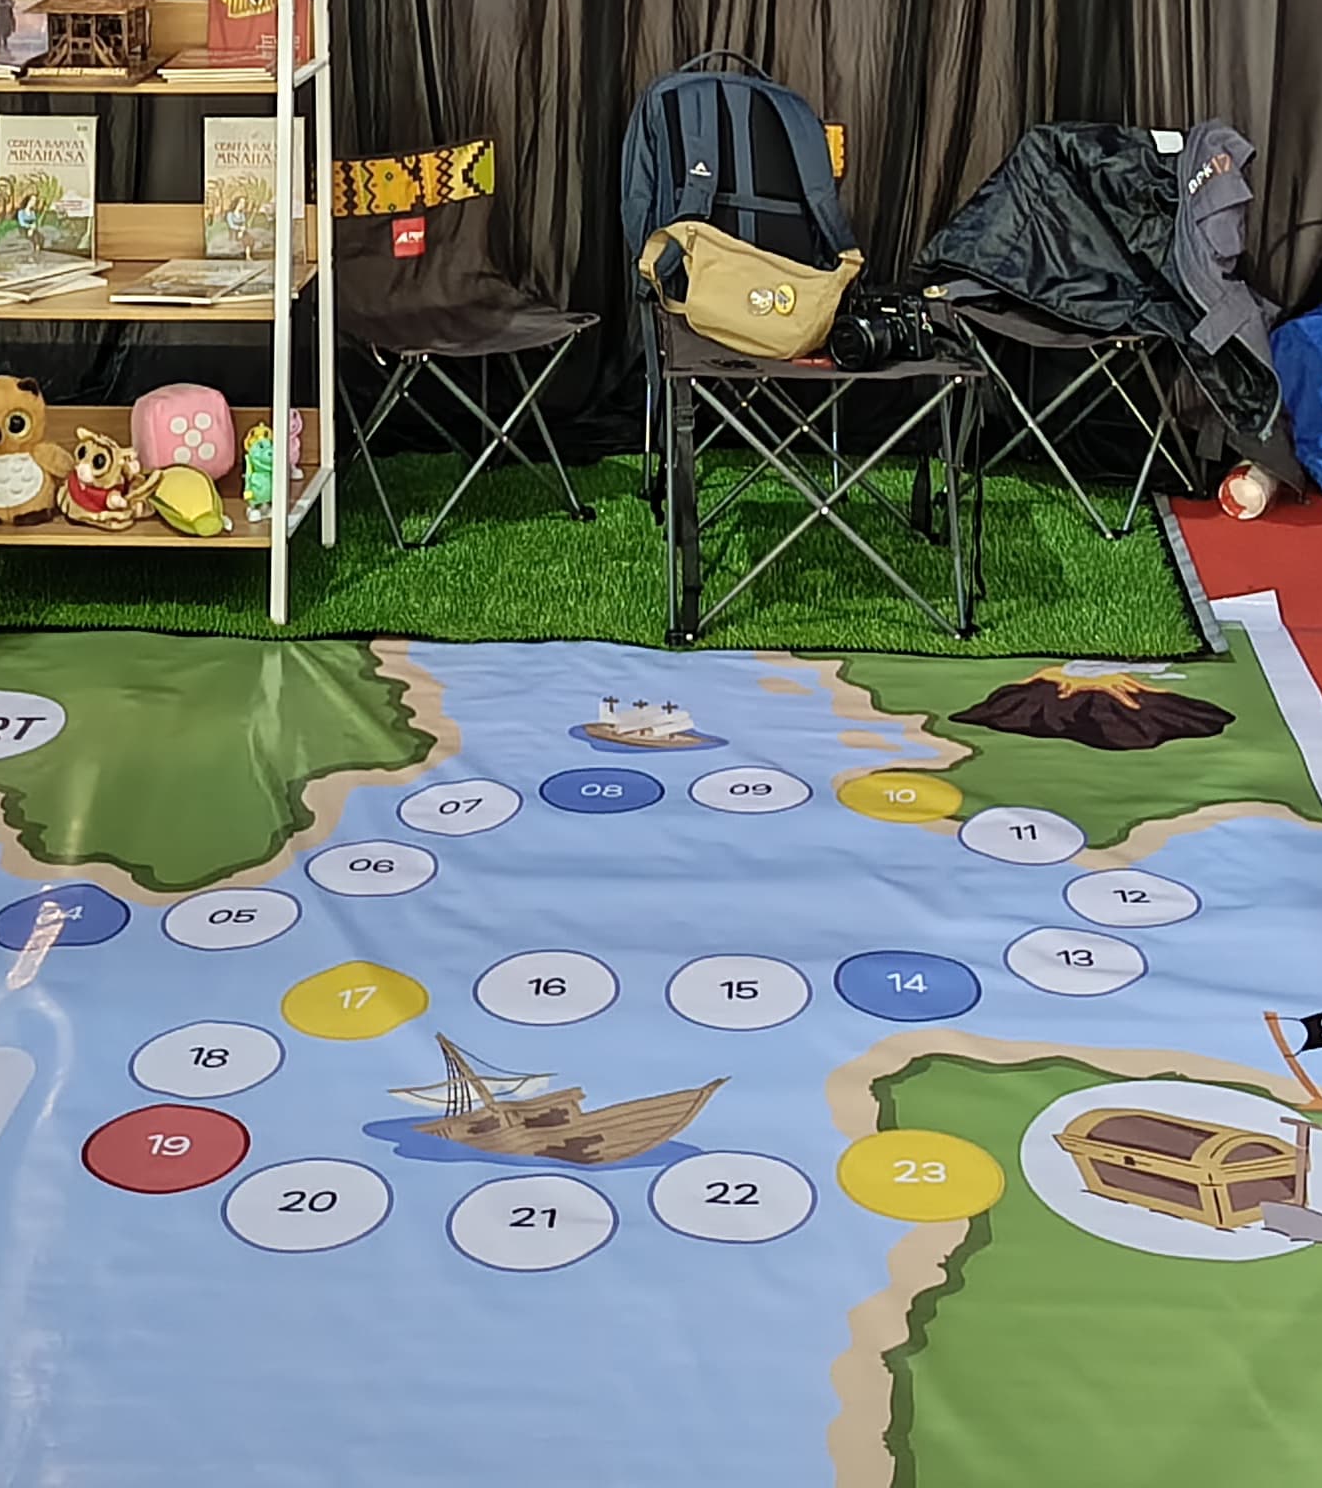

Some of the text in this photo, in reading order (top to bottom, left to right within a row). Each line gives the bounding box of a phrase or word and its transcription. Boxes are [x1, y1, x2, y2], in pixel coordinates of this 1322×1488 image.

[6, 149, 86, 162] MINAHASA
[579, 783, 625, 799] 08
[728, 781, 774, 798] 09
[883, 788, 918, 805] 10
[439, 797, 484, 817] 07
[1010, 823, 1039, 841] 11
[348, 857, 395, 873] 06
[1112, 888, 1152, 905] 12
[208, 908, 256, 925] 05
[1056, 949, 1095, 968] 13
[527, 977, 568, 997] 16
[720, 980, 759, 1002] 15
[887, 972, 928, 995] 14
[337, 985, 377, 1010] 17
[189, 1046, 230, 1070] 18
[147, 1133, 191, 1157] 19
[891, 1161, 948, 1185] 23
[277, 1190, 338, 1214] 20
[704, 1182, 761, 1207] 22
[509, 1207, 558, 1230] 21
